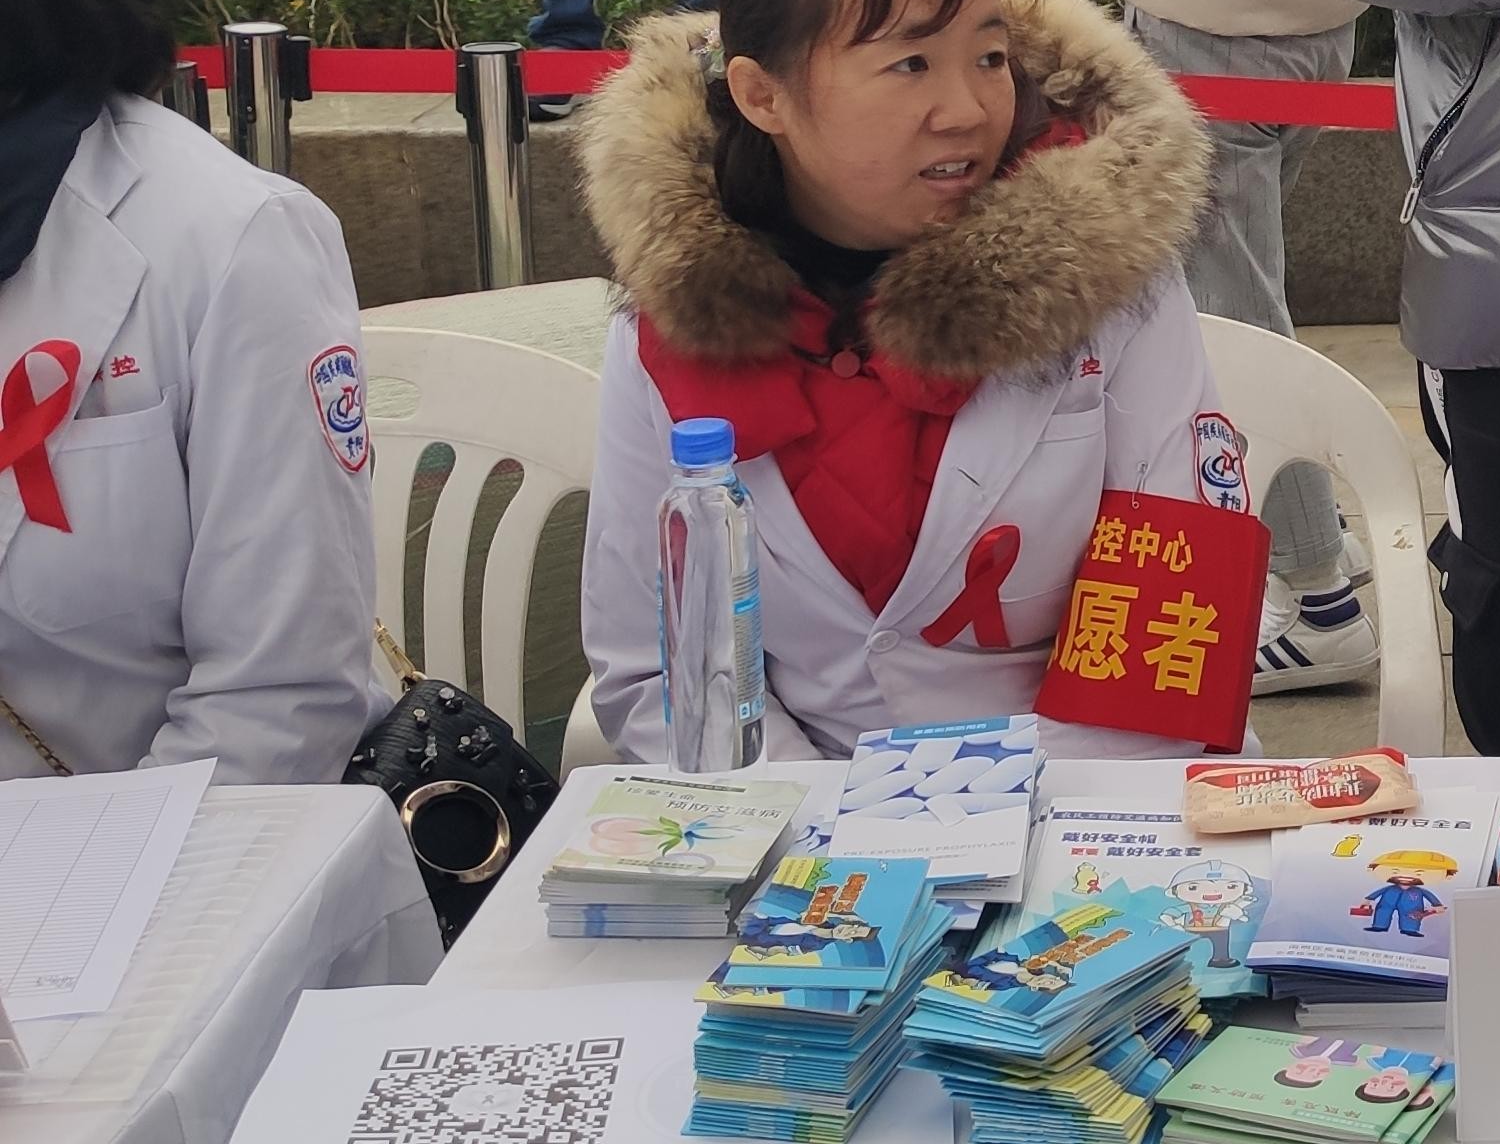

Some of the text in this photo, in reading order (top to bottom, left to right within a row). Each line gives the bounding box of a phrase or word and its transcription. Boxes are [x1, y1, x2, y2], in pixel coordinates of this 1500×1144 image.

[1088, 516, 1193, 572] 控中心
[1047, 579, 1220, 695] 愿者
[666, 800, 783, 819] 预防艾滋病
[1061, 831, 1158, 845] 戴好安全帽
[1106, 846, 1203, 857] 戴好安全套
